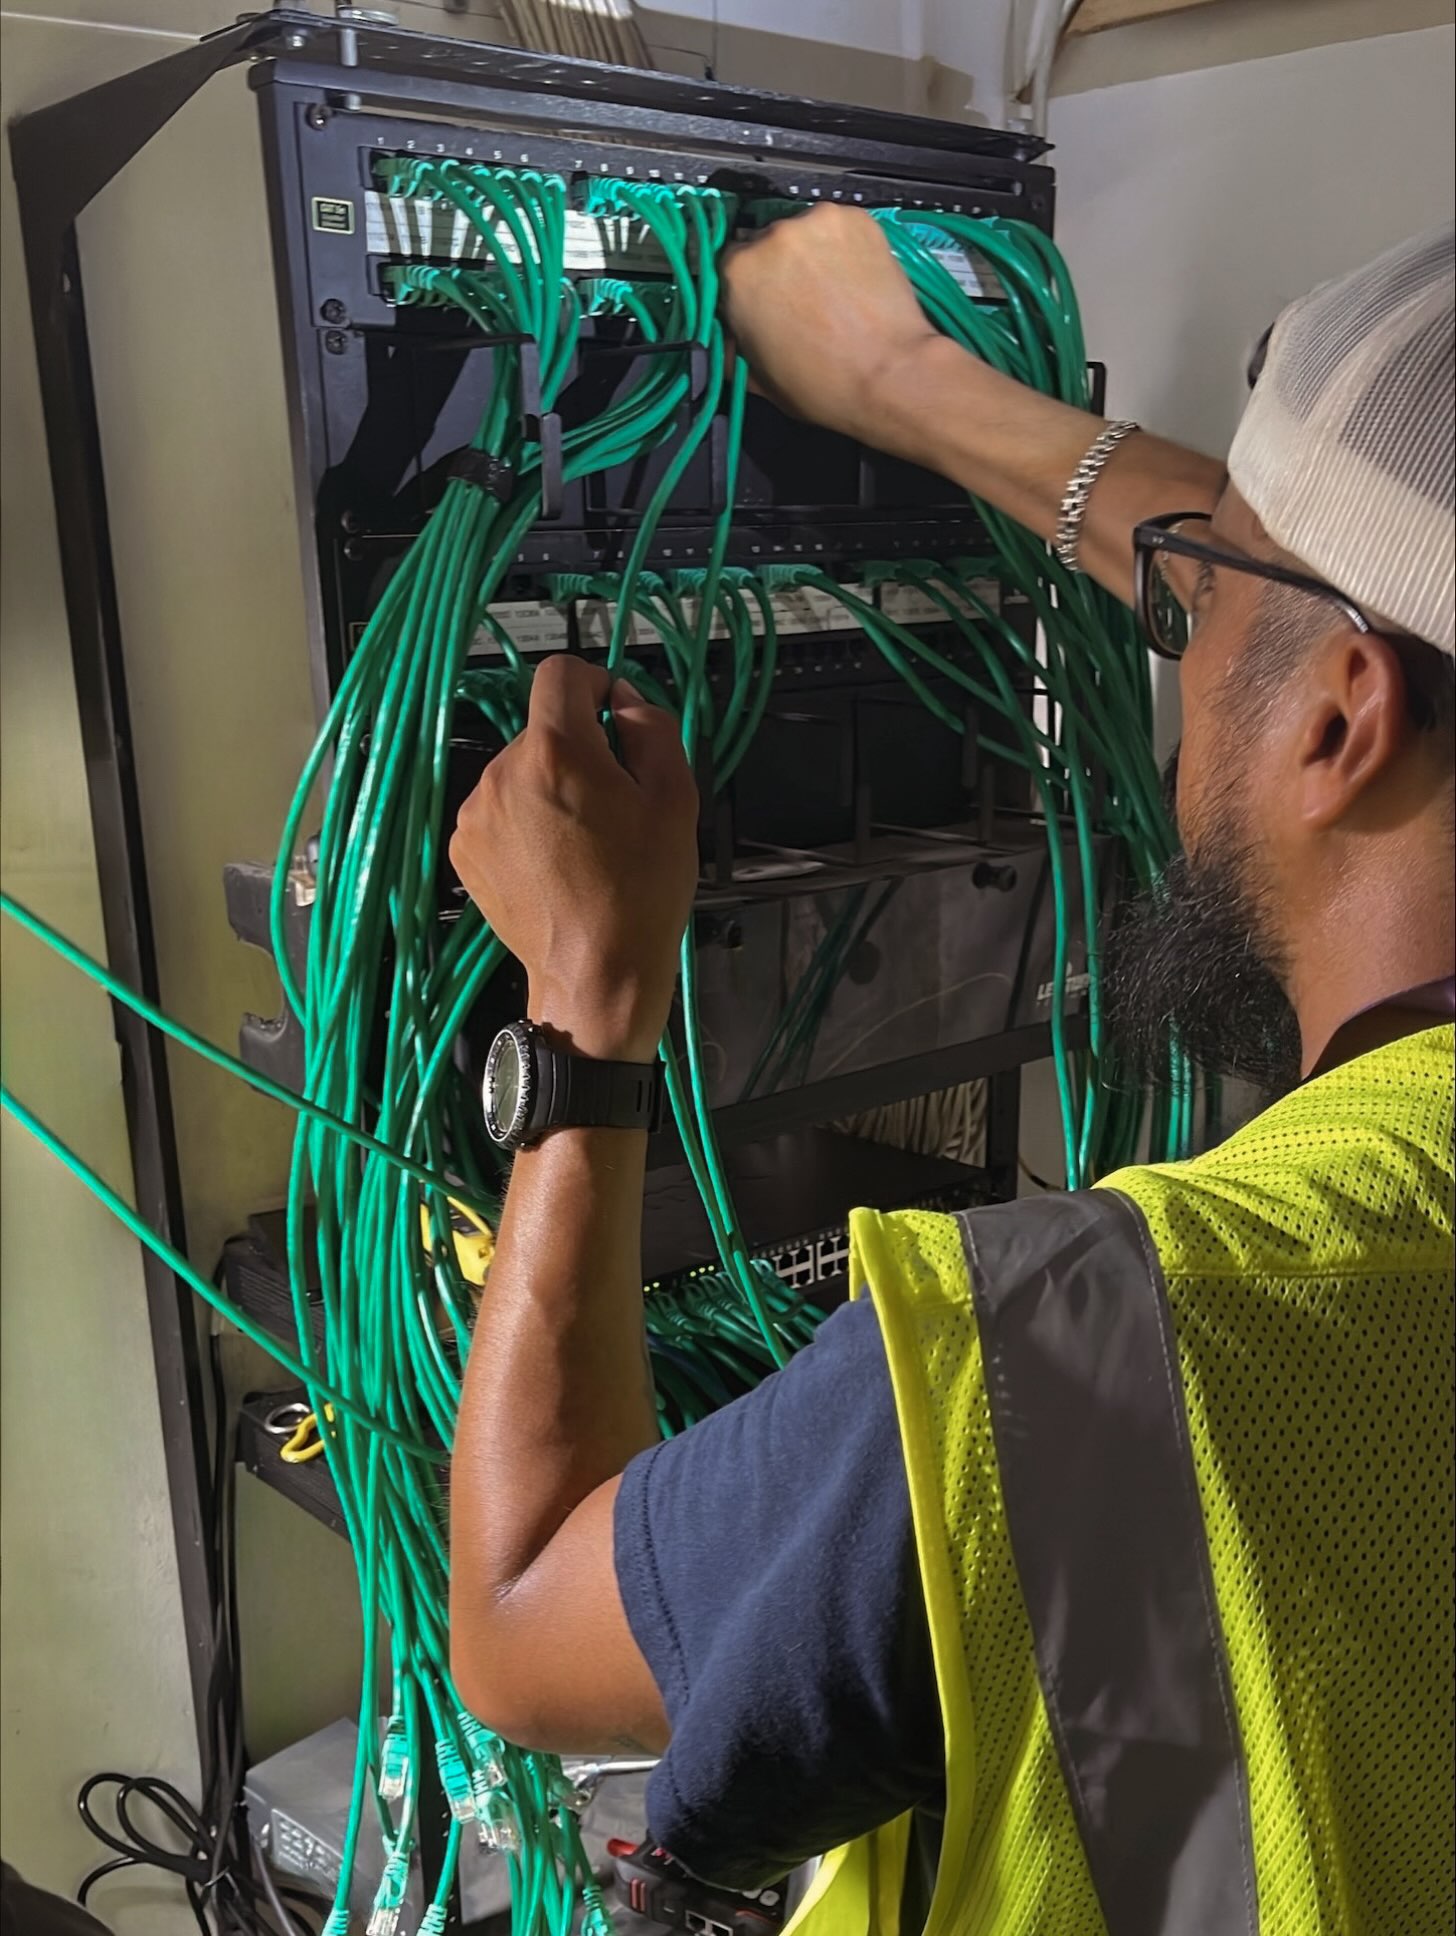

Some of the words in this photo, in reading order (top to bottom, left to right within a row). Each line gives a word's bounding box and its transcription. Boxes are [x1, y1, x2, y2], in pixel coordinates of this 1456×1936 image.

[407, 140, 415, 149] 2
[436, 144, 445, 152] 3
[494, 150, 502, 159] 5
